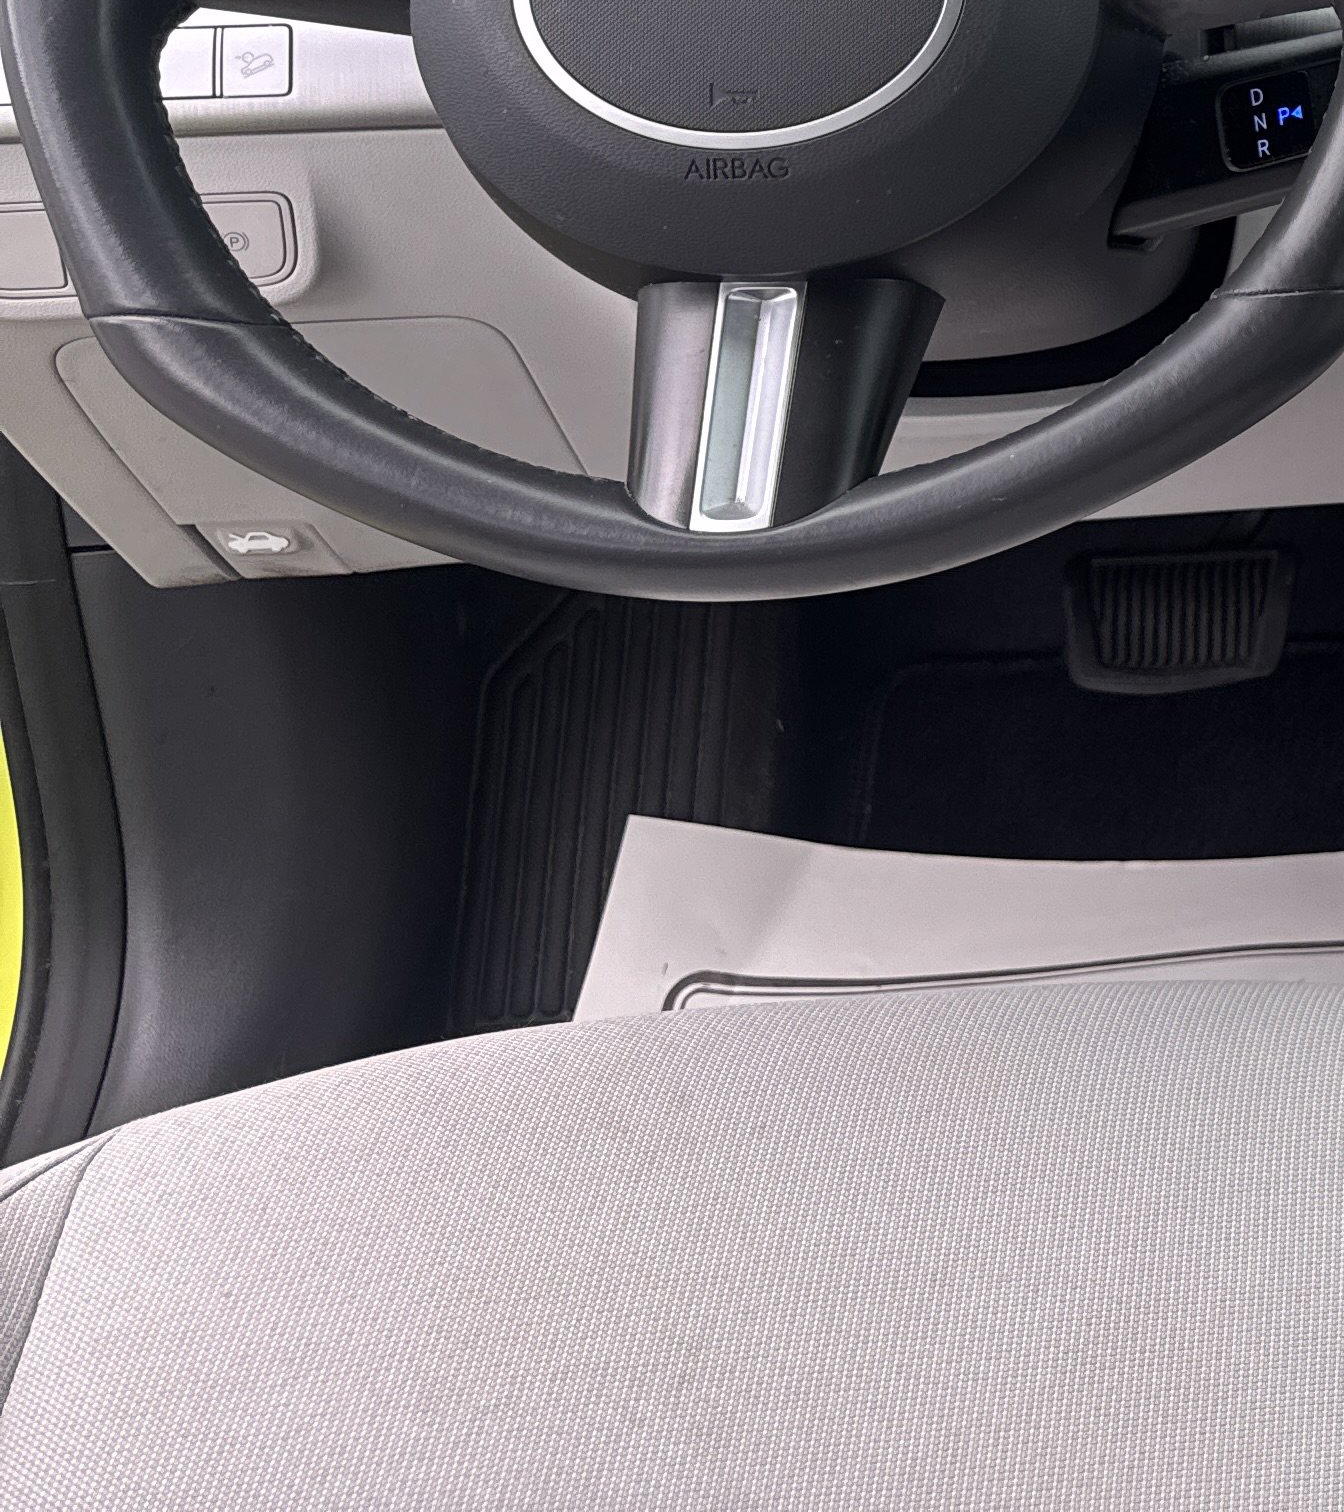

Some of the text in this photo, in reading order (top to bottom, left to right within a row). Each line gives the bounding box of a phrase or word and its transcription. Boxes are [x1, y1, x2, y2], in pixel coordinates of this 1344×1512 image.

[1250, 88, 1264, 106] D
[1253, 112, 1268, 132] N
[1278, 107, 1290, 125] P
[1257, 139, 1271, 158] R
[684, 157, 789, 181] AIRBAG
